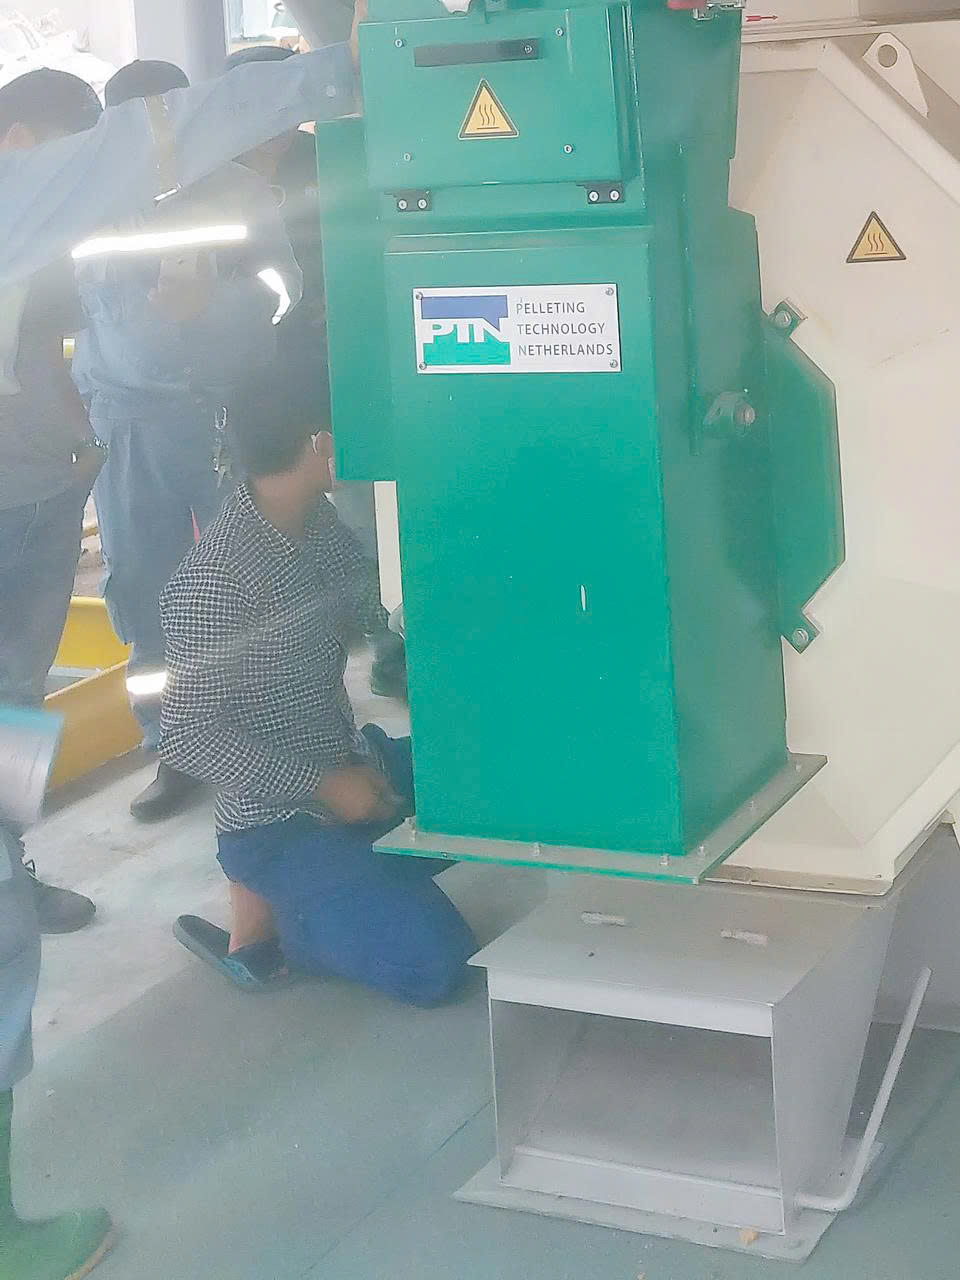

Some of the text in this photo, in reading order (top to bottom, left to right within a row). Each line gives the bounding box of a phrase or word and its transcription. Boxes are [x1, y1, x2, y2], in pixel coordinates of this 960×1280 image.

[516, 301, 585, 314] PELLETING
[517, 322, 606, 335] TECHNOLOGY
[518, 343, 613, 356] NETHERLANDS
